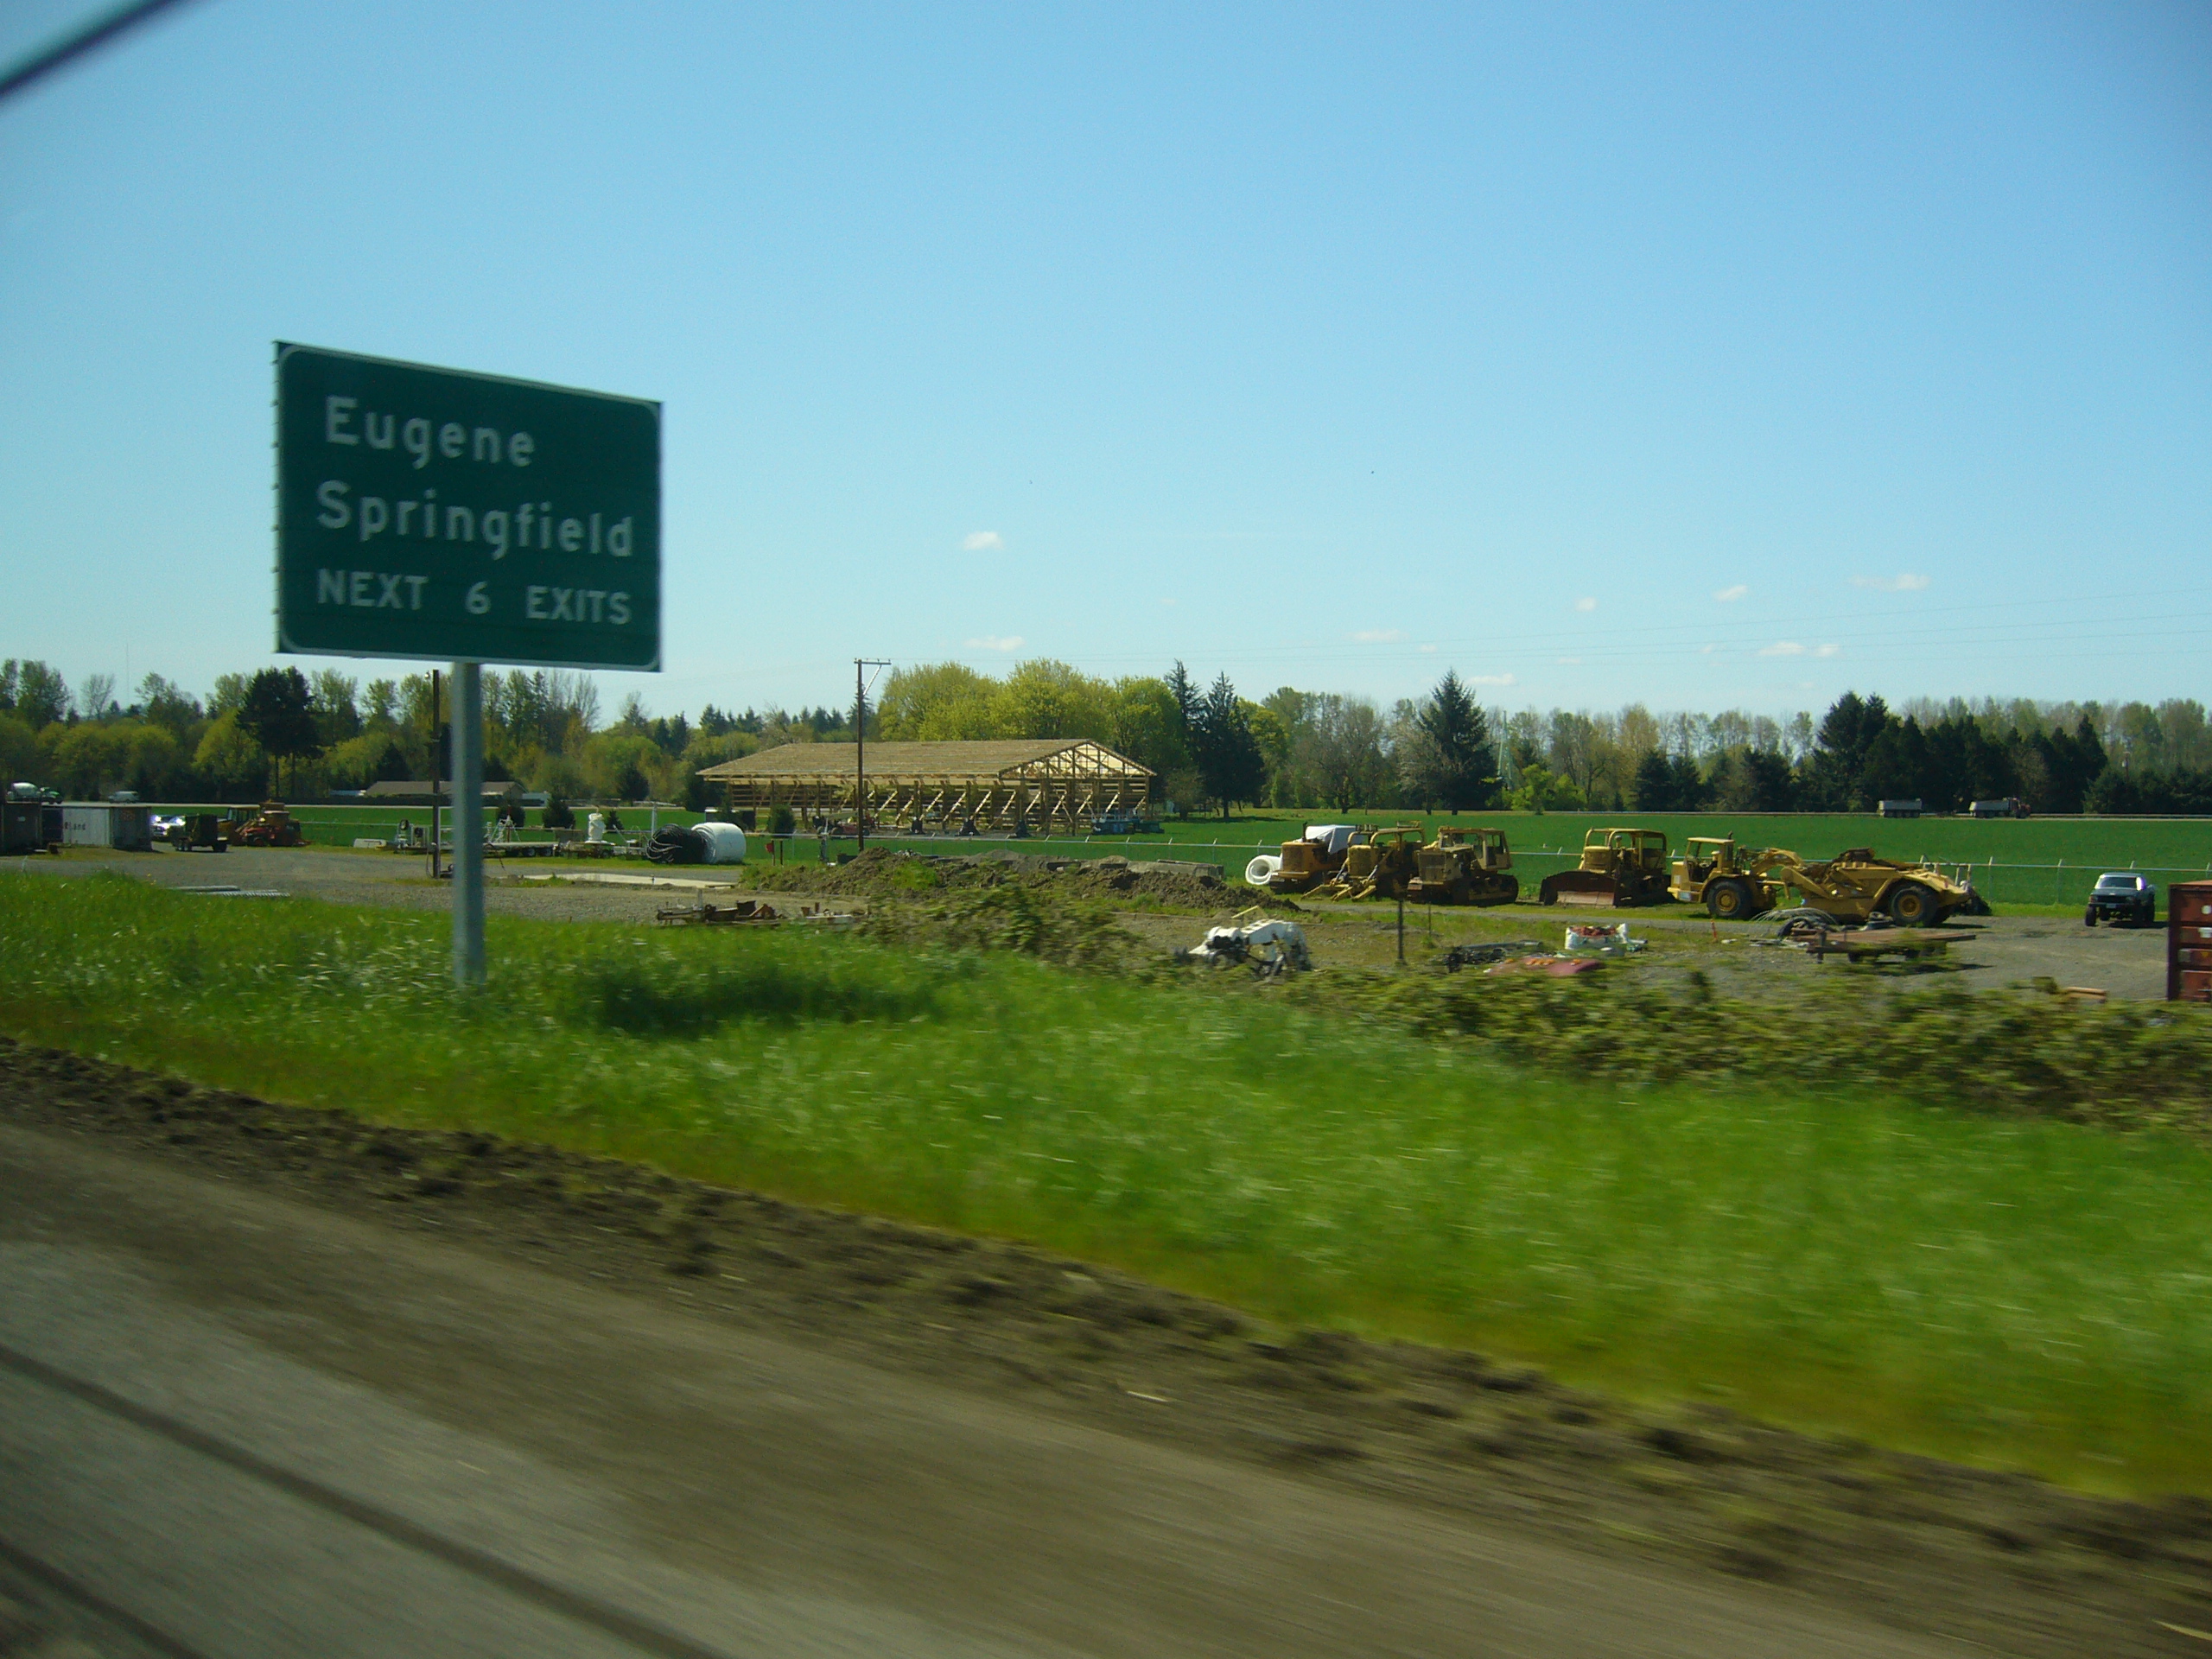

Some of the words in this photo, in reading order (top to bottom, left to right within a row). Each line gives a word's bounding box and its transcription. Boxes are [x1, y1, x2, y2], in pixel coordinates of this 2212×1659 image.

[325, 395, 536, 468] Eugene
[317, 480, 633, 560] Springfield
[318, 568, 429, 609] NEXT
[465, 581, 490, 615] 6
[526, 585, 632, 626] EXITS
